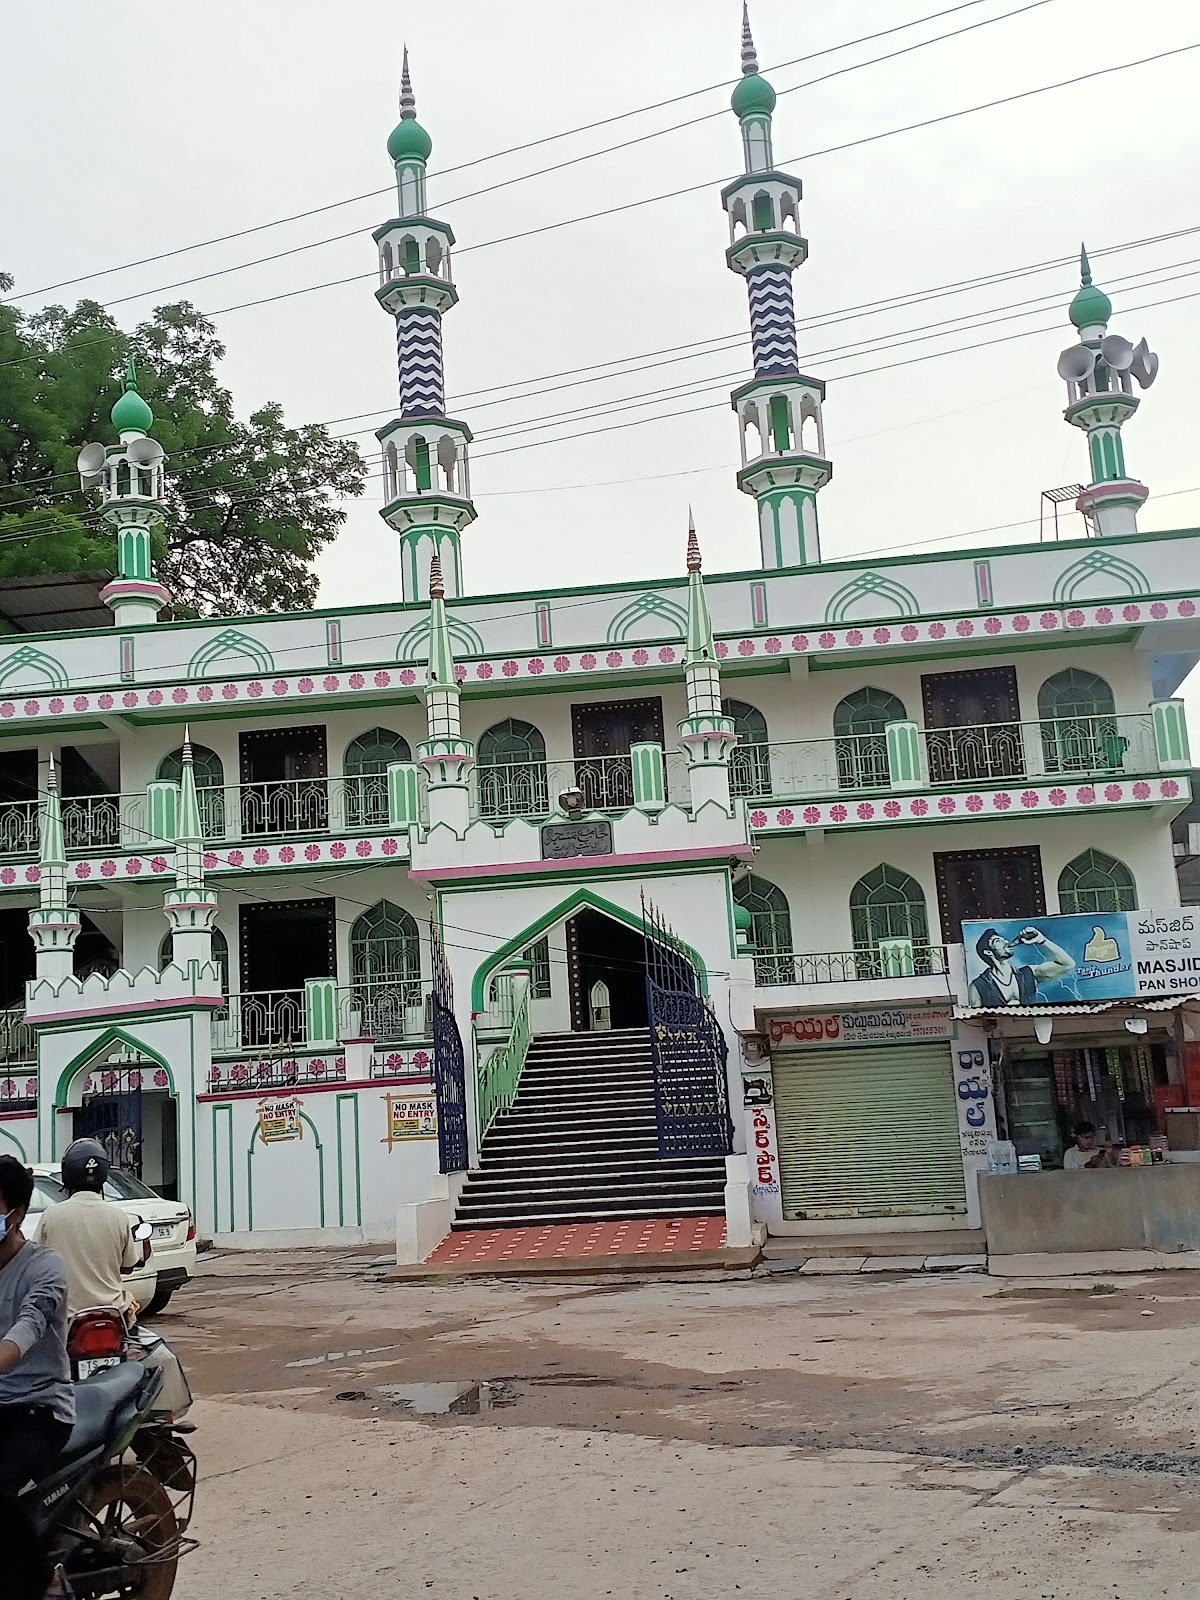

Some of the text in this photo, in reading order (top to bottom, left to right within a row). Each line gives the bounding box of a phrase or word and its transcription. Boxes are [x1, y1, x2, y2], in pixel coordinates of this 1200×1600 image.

[1090, 964, 1131, 977] Thunder
[1137, 958, 1200, 974] MASJID
[1139, 977, 1200, 990] PAN SHO
[769, 1015, 840, 1042] రాయల్
[275, 1102, 295, 1111] MASK
[410, 1102, 433, 1110] MASK
[263, 1109, 296, 1120] NO ENTRY
[408, 1109, 435, 1118] ENTRY
